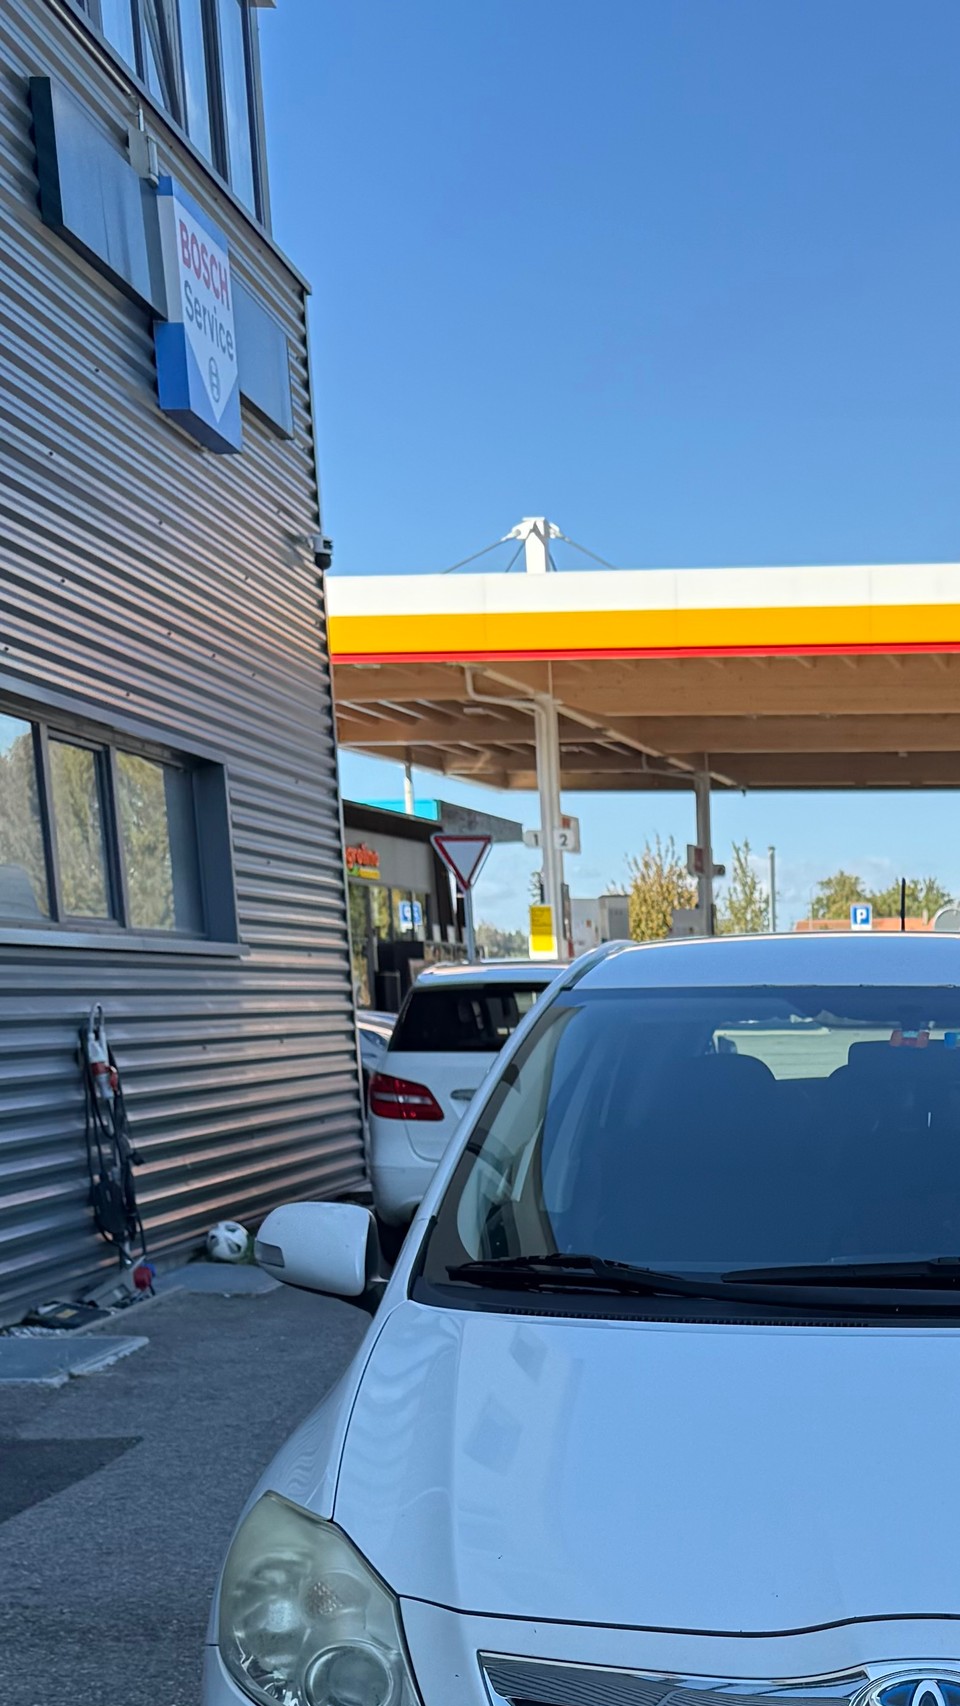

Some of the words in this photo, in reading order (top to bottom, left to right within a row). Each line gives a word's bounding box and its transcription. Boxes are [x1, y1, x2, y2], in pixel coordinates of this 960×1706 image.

[179, 218, 231, 311] BOSCH
[184, 280, 234, 362] Service
[559, 834, 568, 847] 2
